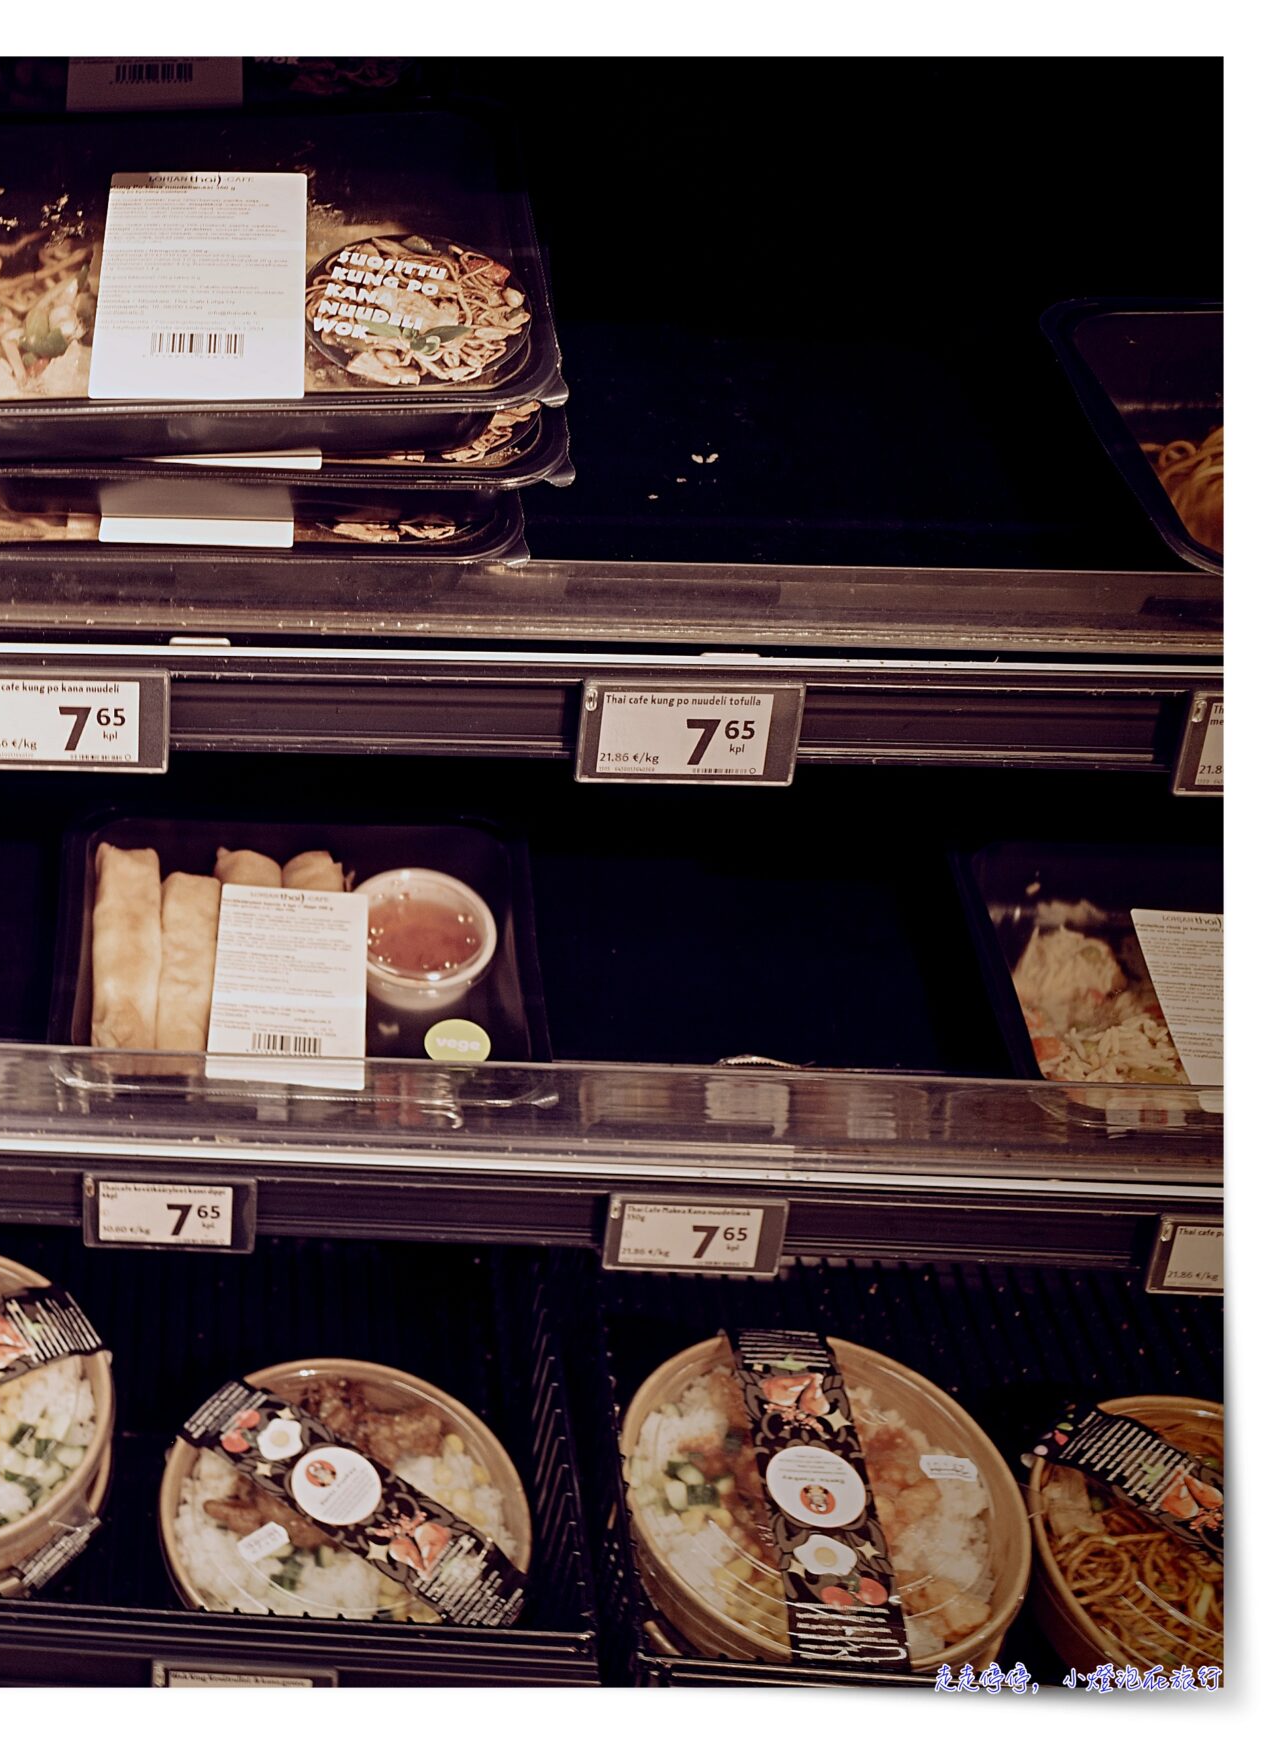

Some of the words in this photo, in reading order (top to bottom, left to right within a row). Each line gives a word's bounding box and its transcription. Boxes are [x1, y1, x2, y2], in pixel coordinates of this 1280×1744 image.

[336, 250, 447, 281] SUOSITTU
[330, 266, 399, 289] KUNG
[406, 279, 439, 296] PO
[324, 282, 394, 306] KANA
[318, 299, 424, 330] NUUDELI
[312, 317, 370, 340] WOK
[0, 682, 20, 692] cafe
[21, 682, 45, 695] kung
[47, 684, 59, 695] po
[61, 683, 84, 693] kana
[85, 684, 120, 694] nuudeli
[605, 694, 626, 705] Thai
[628, 696, 649, 706] cafe
[650, 696, 674, 708] kung
[676, 698, 689, 708] po
[691, 696, 727, 707] nuudeli
[729, 697, 761, 707] tofulla
[58, 706, 92, 752] 7
[96, 707, 126, 727] 65
[102, 730, 119, 742] kpl
[11, 737, 38, 750] €/kg
[686, 718, 722, 766] 7
[724, 720, 755, 740] 65
[729, 744, 745, 755] kpl
[599, 752, 629, 763] 21.86
[632, 752, 660, 765] €/kg
[434, 1037, 481, 1053] vege
[627, 1205, 644, 1214] Thai
[645, 1206, 661, 1214] Cafe
[687, 1208, 707, 1216] Kana
[166, 1203, 193, 1236] 7
[196, 1205, 221, 1220] 65
[201, 1221, 215, 1230] kpl
[1179, 1227, 1196, 1236] Thai
[1198, 1228, 1214, 1236] cafe
[692, 1224, 721, 1259] 7
[723, 1226, 748, 1242] 65
[726, 1243, 740, 1252] kpl
[1167, 1270, 1193, 1279] 21.86
[1195, 1271, 1219, 1282] €/kg
